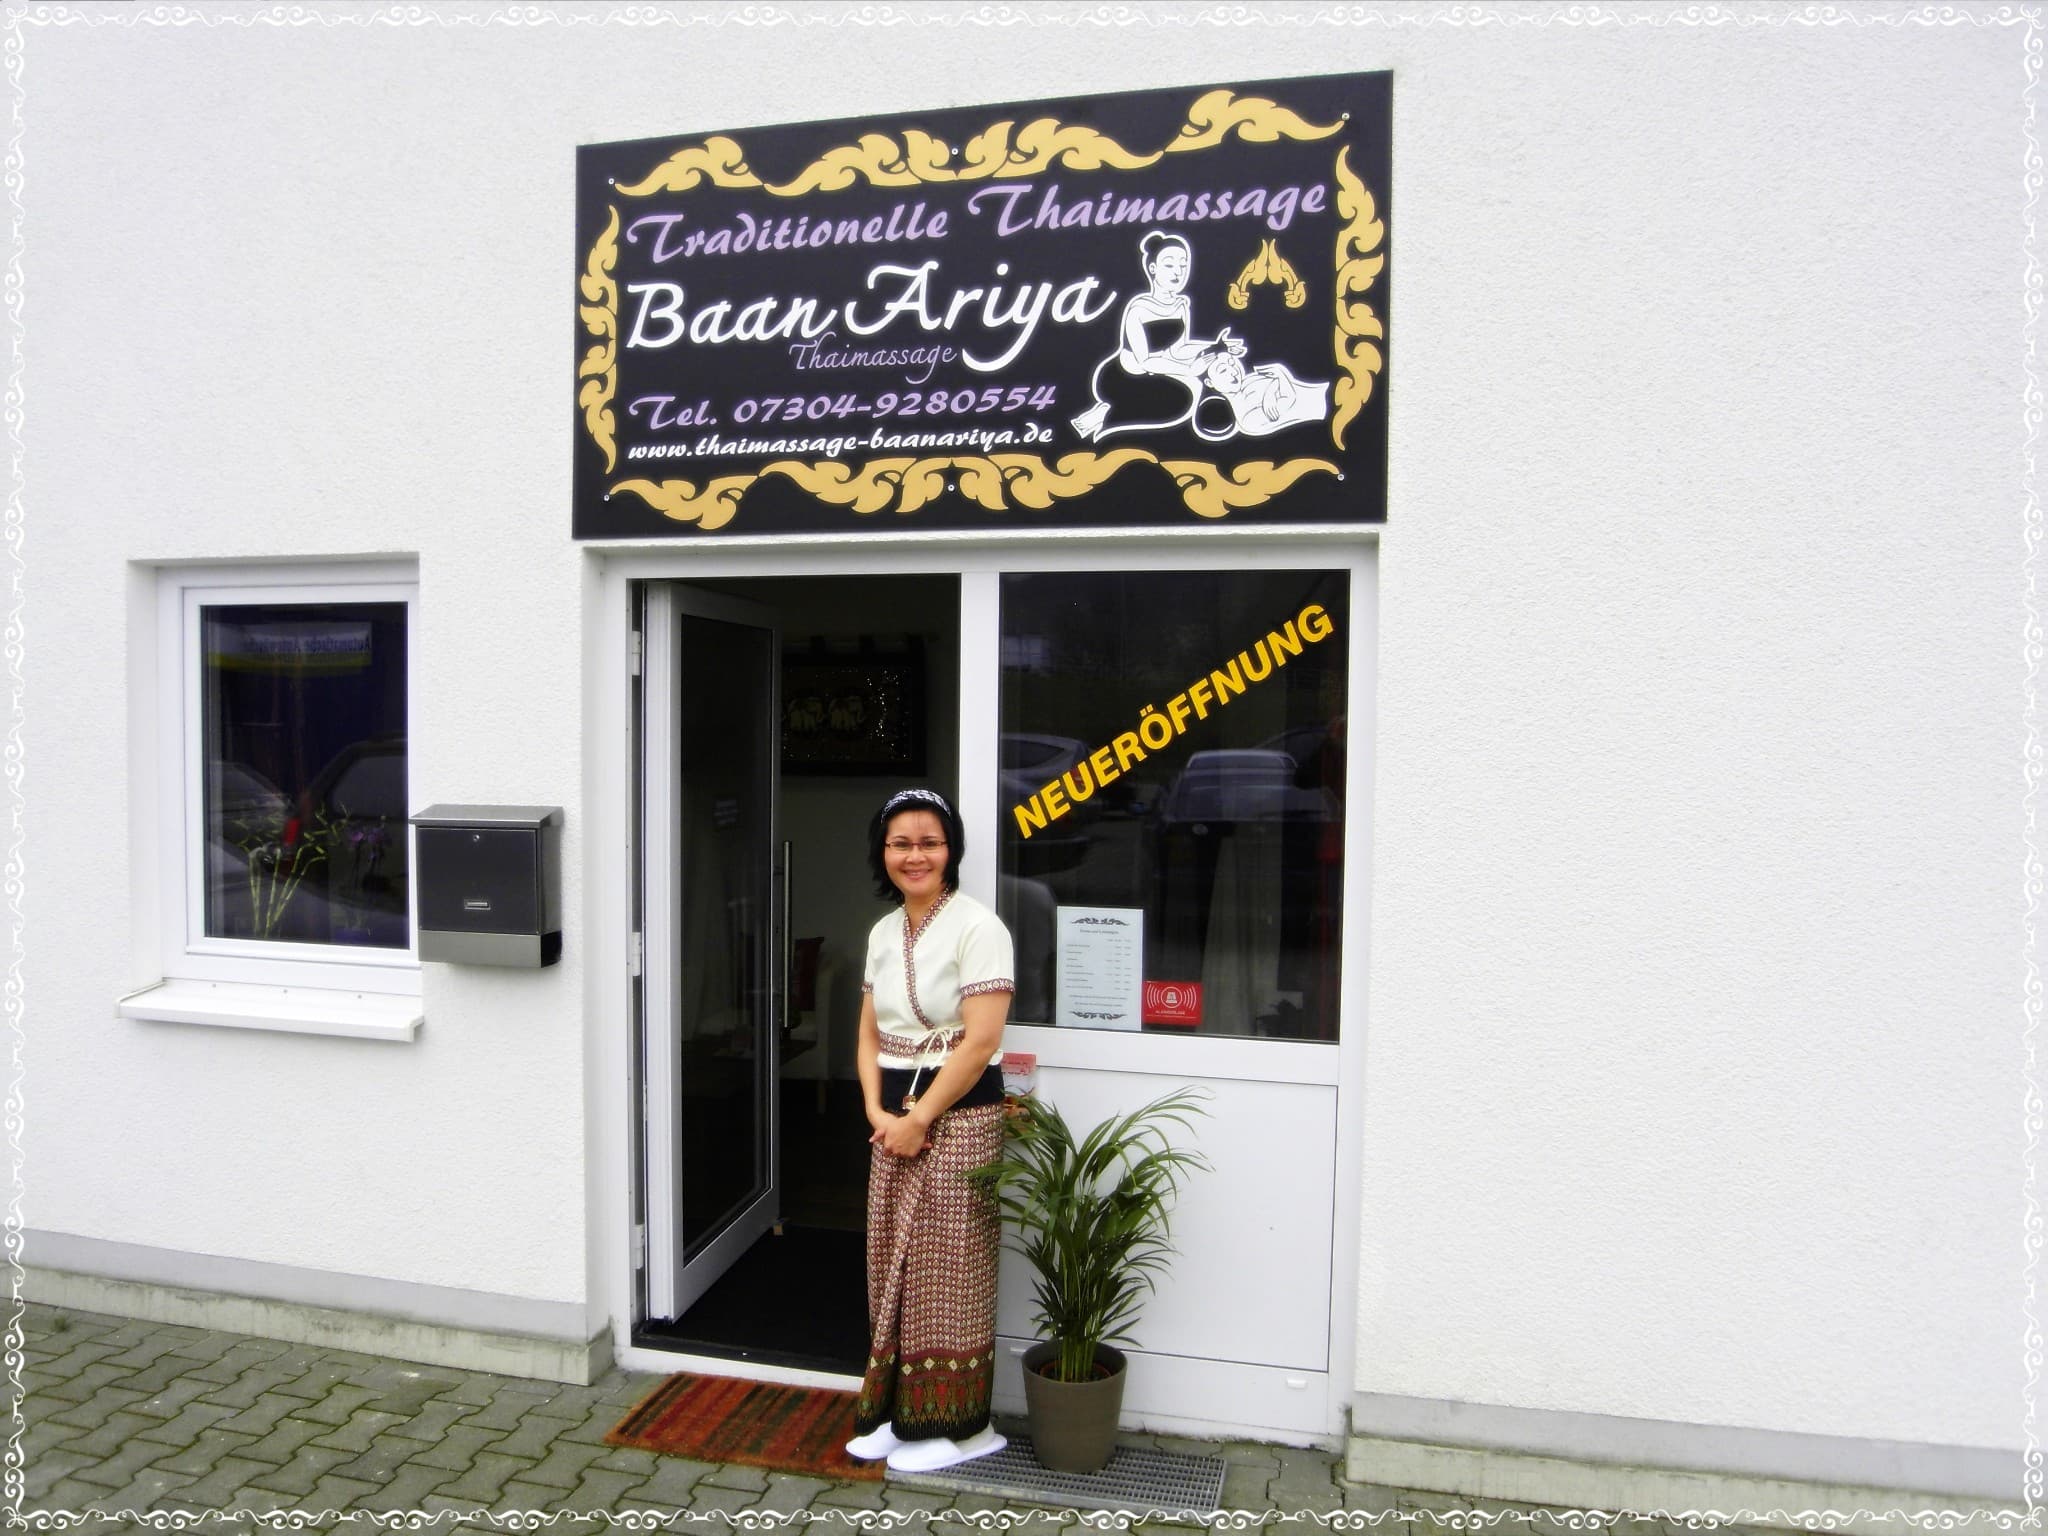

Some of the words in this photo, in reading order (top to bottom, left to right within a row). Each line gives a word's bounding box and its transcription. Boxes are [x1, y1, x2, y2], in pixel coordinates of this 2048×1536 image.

[626, 202, 949, 264] Traditionelle
[967, 184, 1327, 237] Thaimassage
[626, 282, 838, 349] Baan
[844, 260, 1118, 372] Ariya
[788, 331, 957, 384] Thaimassage
[627, 422, 1054, 460] www.thaimassage-baanariya.de
[628, 396, 718, 431] Tel.
[733, 385, 1057, 425] 07304-9280554
[1013, 604, 1334, 840] NEUERÖFFNUNG
